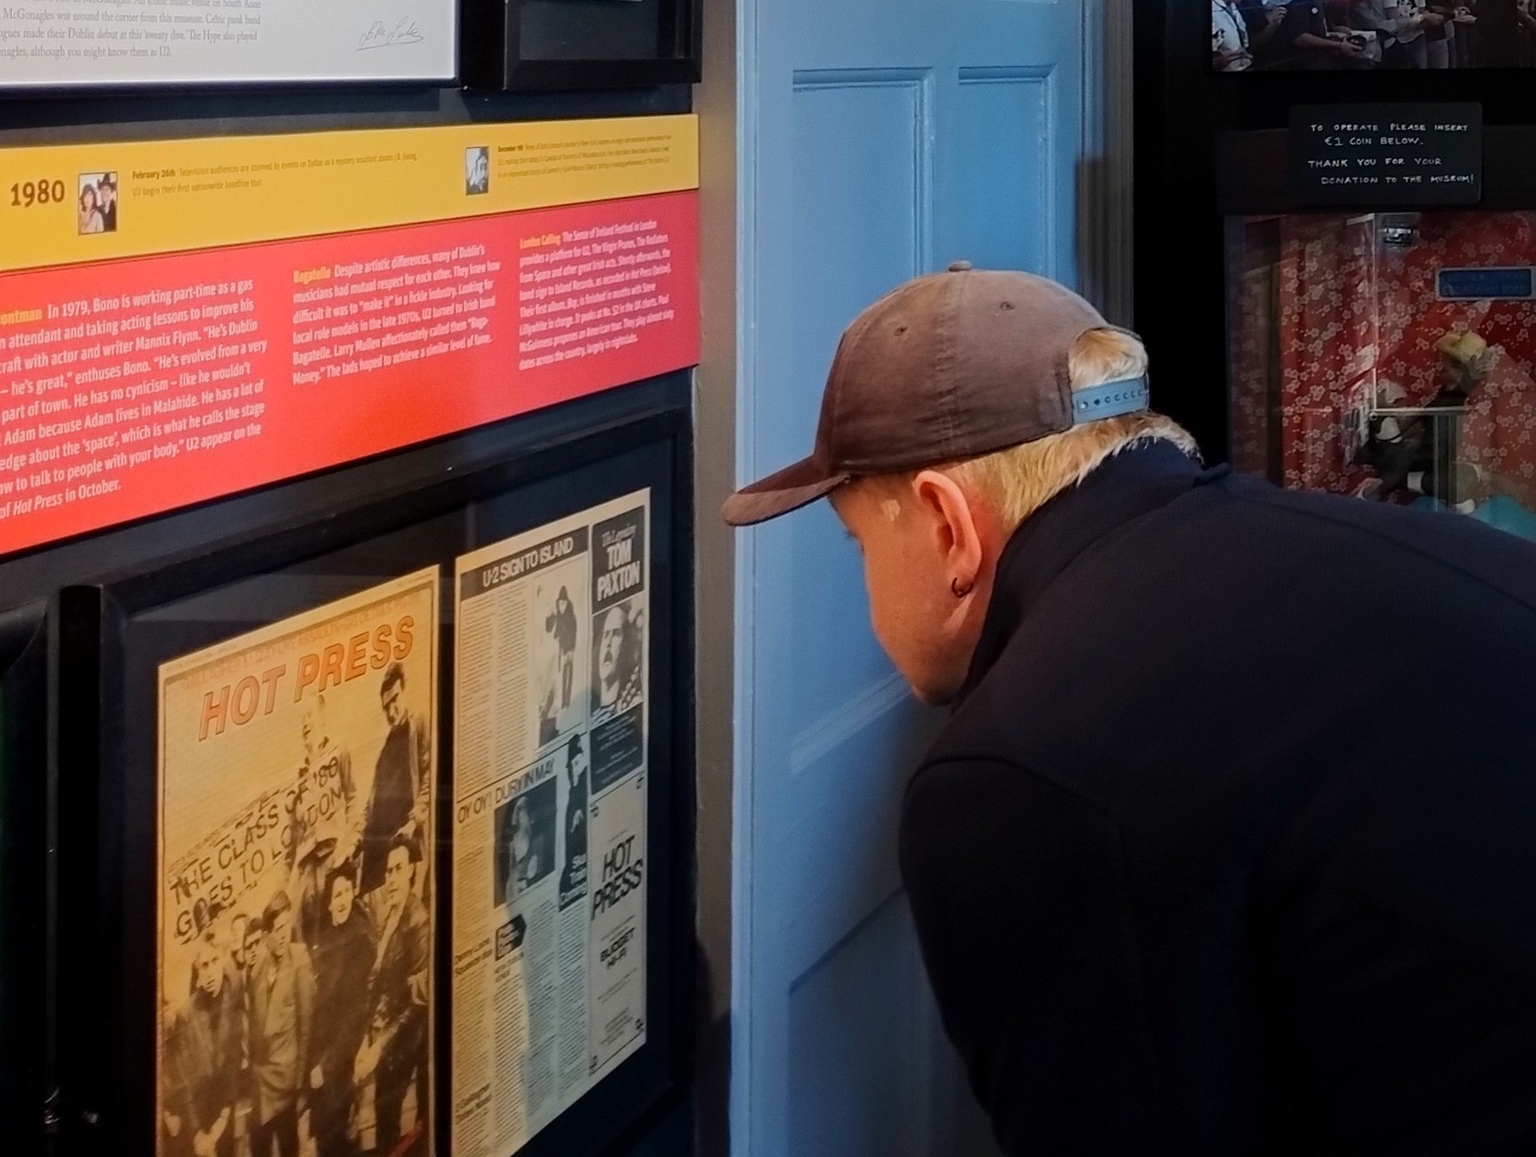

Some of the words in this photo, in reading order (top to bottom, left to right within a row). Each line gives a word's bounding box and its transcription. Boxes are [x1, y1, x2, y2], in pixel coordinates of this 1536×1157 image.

[102, 11, 114, 22] the
[1310, 124, 1323, 132] TO
[1333, 124, 1379, 132] OPERATE
[1390, 123, 1426, 132] PLEASE
[1434, 124, 1469, 132] INSERT
[1324, 136, 1343, 146] €1
[1349, 137, 1372, 145] COIN
[1308, 159, 1348, 168] THANK
[1357, 158, 1377, 166] YOU
[1385, 157, 1405, 165] FOR
[1414, 157, 1442, 165] YOUR
[1321, 176, 1378, 185] DONATION
[1402, 175, 1423, 183] THE
[1430, 174, 1475, 184] MUSEUM!
[10, 179, 65, 207] 1980
[48, 304, 59, 319] In
[62, 300, 91, 317] 1979,
[93, 297, 119, 313] Bono
[121, 294, 130, 308] is
[133, 290, 172, 305] working
[173, 284, 216, 303] part-time
[218, 283, 228, 294] as
[237, 279, 254, 294] gas
[8, 328, 62, 349] attendant
[64, 323, 84, 340] and
[86, 319, 119, 336] taking
[121, 314, 151, 331] acting
[153, 310, 189, 326] lessons
[190, 308, 200, 321] to
[202, 302, 239, 320] improve
[240, 298, 254, 312] his
[13, 499, 33, 516] Hot
[34, 492, 63, 510] Press
[65, 488, 76, 503] in
[78, 479, 122, 499] October.
[500, 556, 524, 581] SIGN
[524, 552, 538, 570] TO
[540, 537, 574, 564] ISLAND
[607, 539, 632, 570] TOM
[597, 561, 641, 602] PAXTON
[198, 664, 286, 742] HOT
[294, 615, 414, 703] PRESS
[170, 857, 212, 905] THE
[218, 804, 279, 870] CLASS
[240, 849, 264, 884] TO
[602, 835, 635, 882] HOT
[591, 859, 643, 921] PRESS
